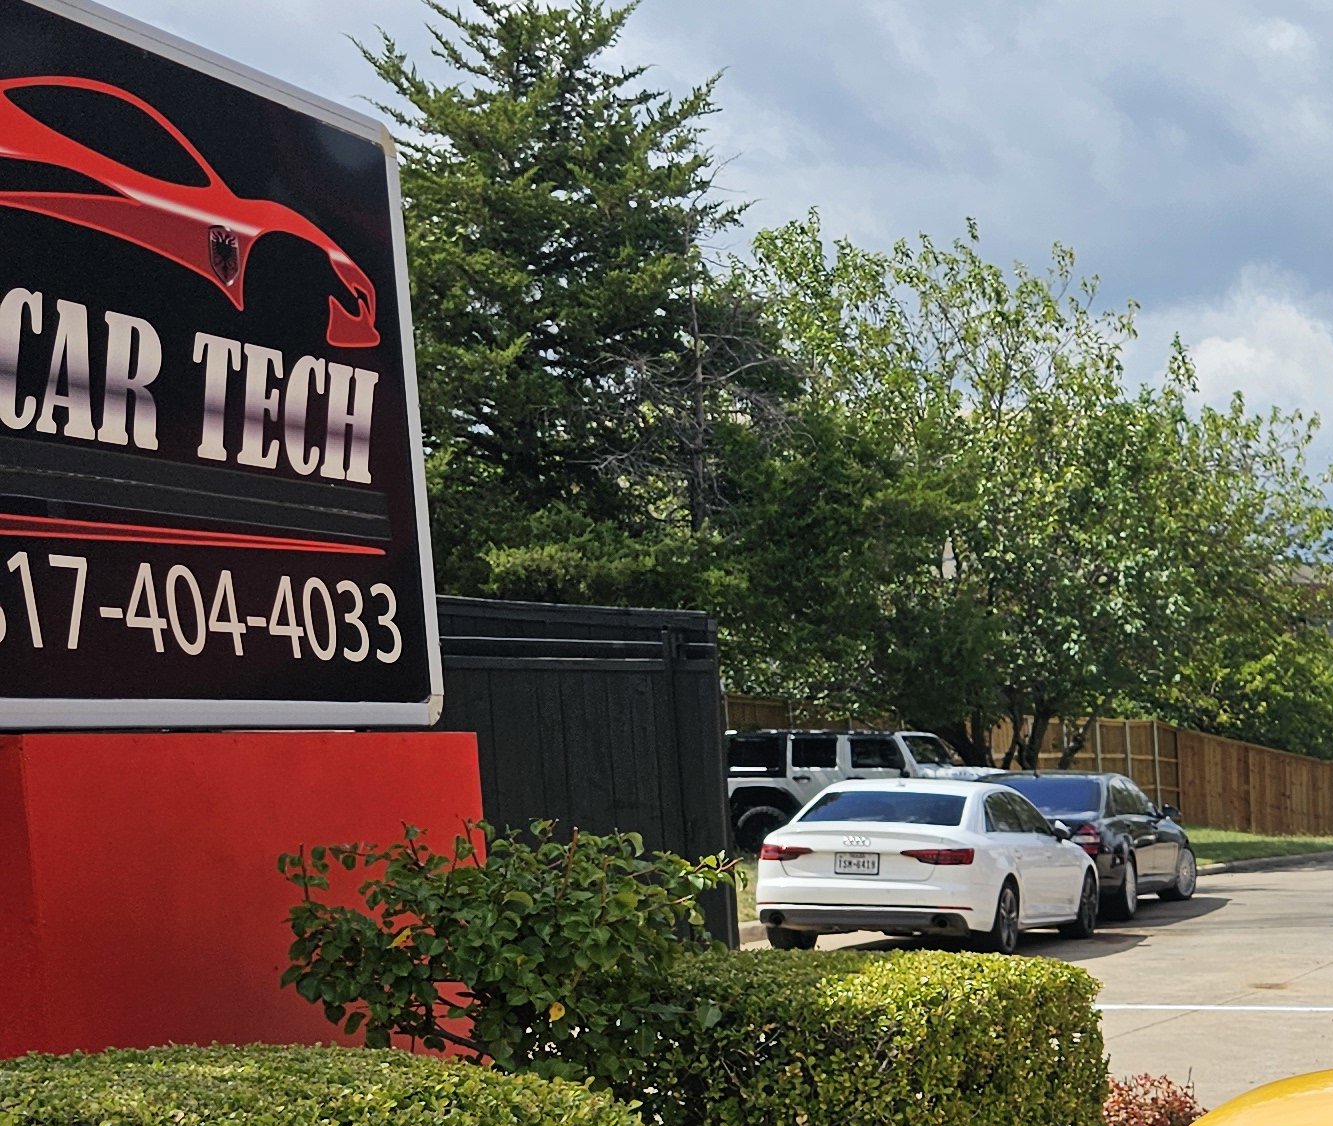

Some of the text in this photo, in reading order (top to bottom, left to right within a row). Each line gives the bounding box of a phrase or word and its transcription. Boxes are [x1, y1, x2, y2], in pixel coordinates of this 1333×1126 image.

[0, 288, 379, 484] CAR TECH
[0, 552, 402, 664] 17-404-4033
